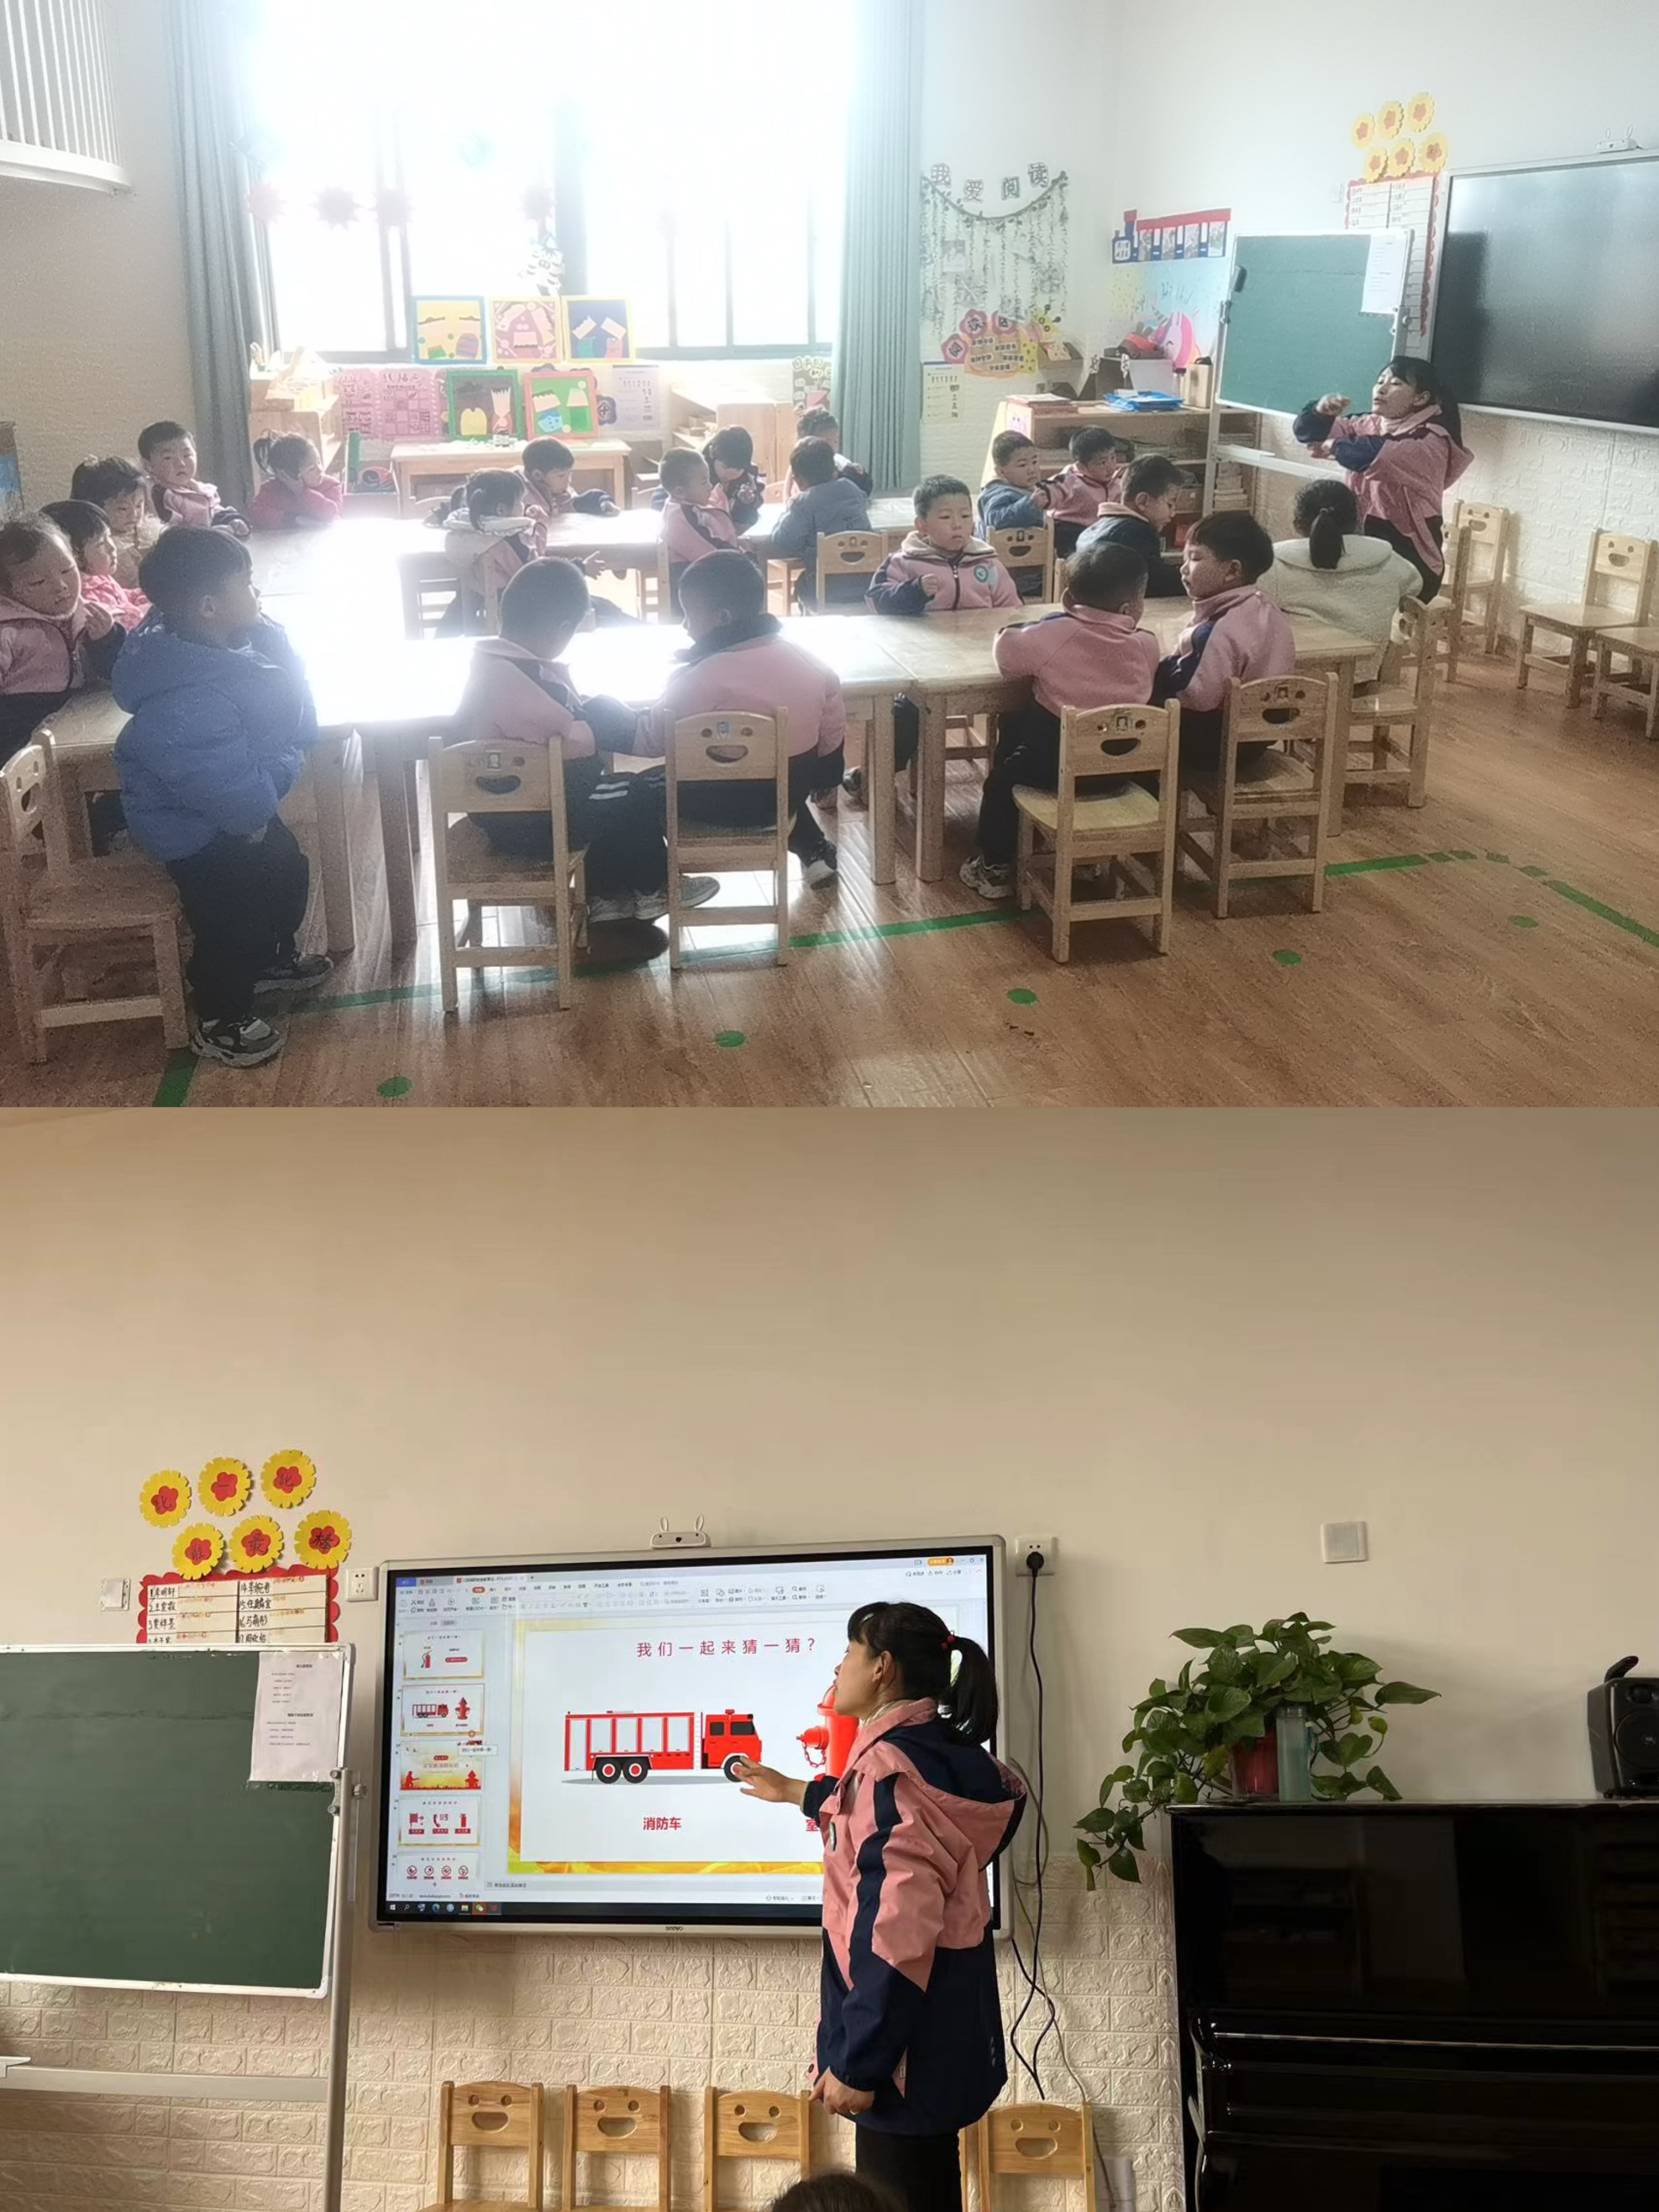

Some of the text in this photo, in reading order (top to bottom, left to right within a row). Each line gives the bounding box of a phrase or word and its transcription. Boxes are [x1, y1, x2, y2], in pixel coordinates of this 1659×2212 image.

[931, 163, 1048, 204] 我爱阅读
[637, 1637, 815, 1657] 我们一起来猜一猜？
[643, 1817, 682, 1830] 消防车
